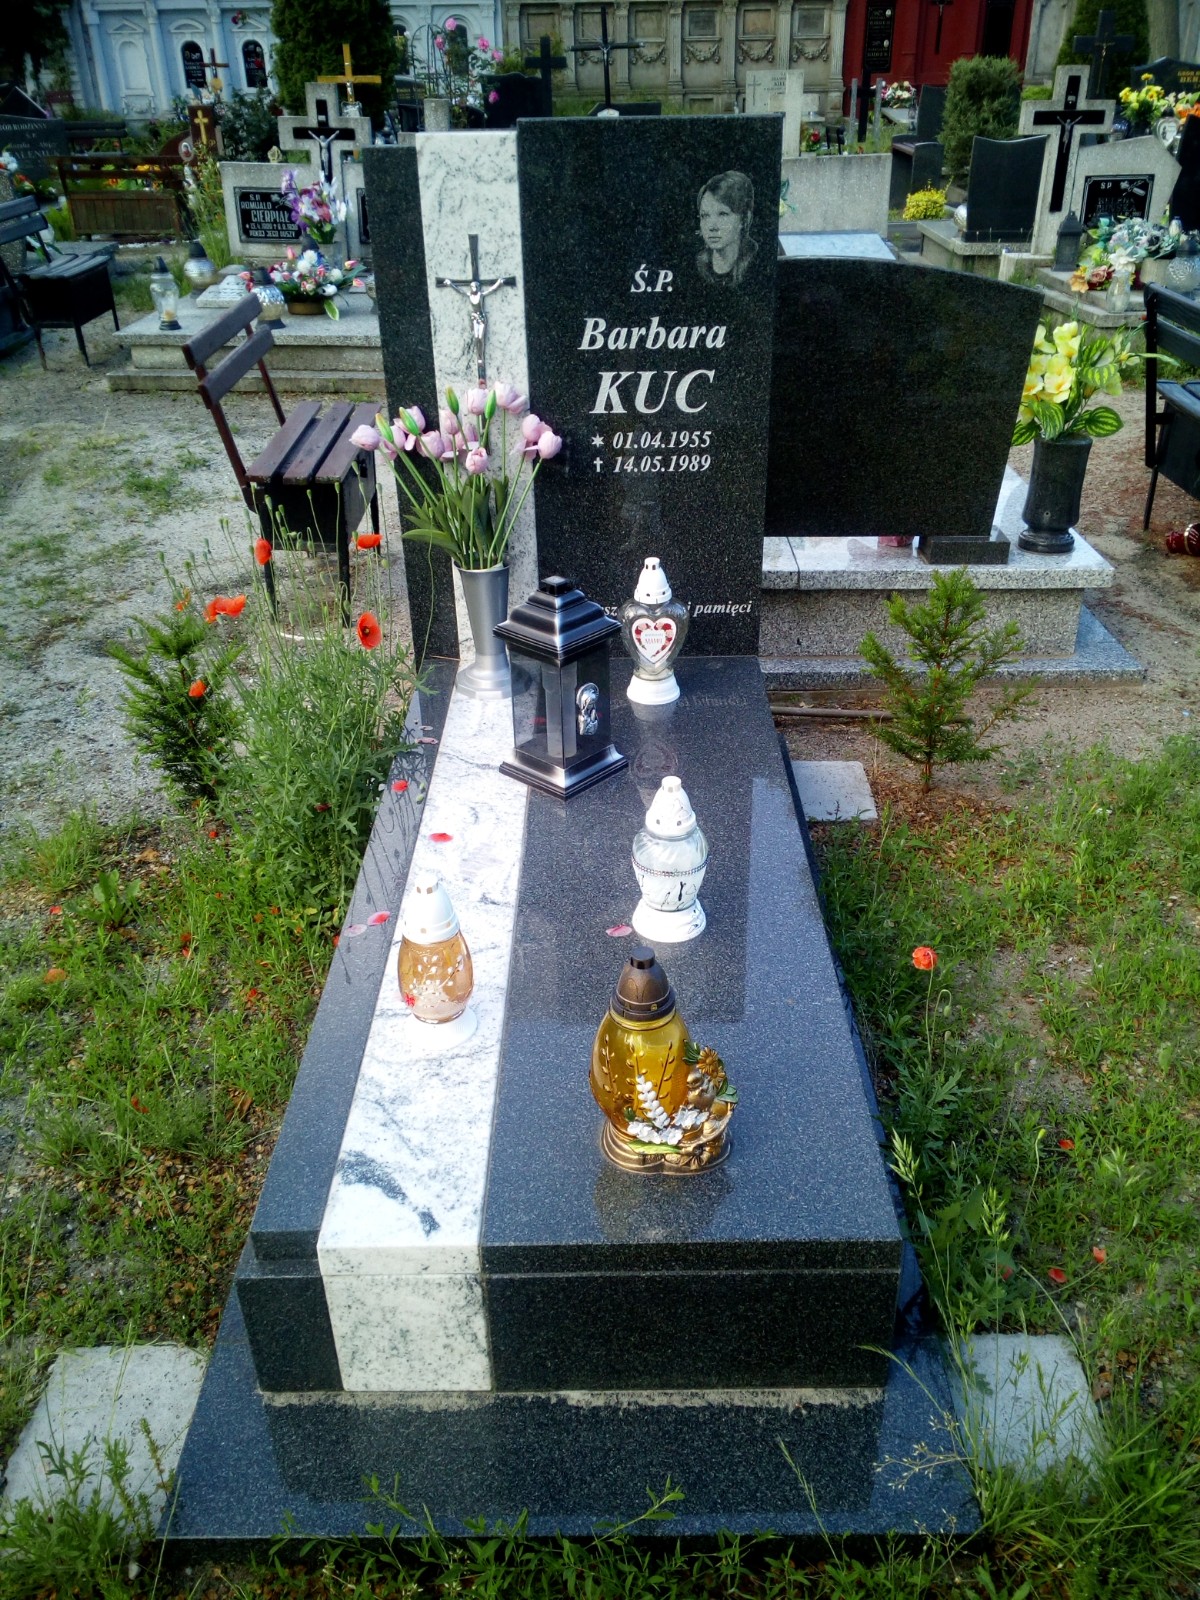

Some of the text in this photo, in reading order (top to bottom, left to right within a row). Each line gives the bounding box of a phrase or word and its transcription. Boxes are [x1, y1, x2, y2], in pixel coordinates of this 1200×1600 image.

[240, 201, 272, 209] ROMUALD
[630, 264, 674, 293] Ś.P.
[577, 316, 727, 351] Barbara
[589, 369, 716, 414] KUC
[612, 430, 712, 449] 01.04.1955
[613, 454, 712, 473] 14.05.1989
[692, 601, 752, 617] pamięci
